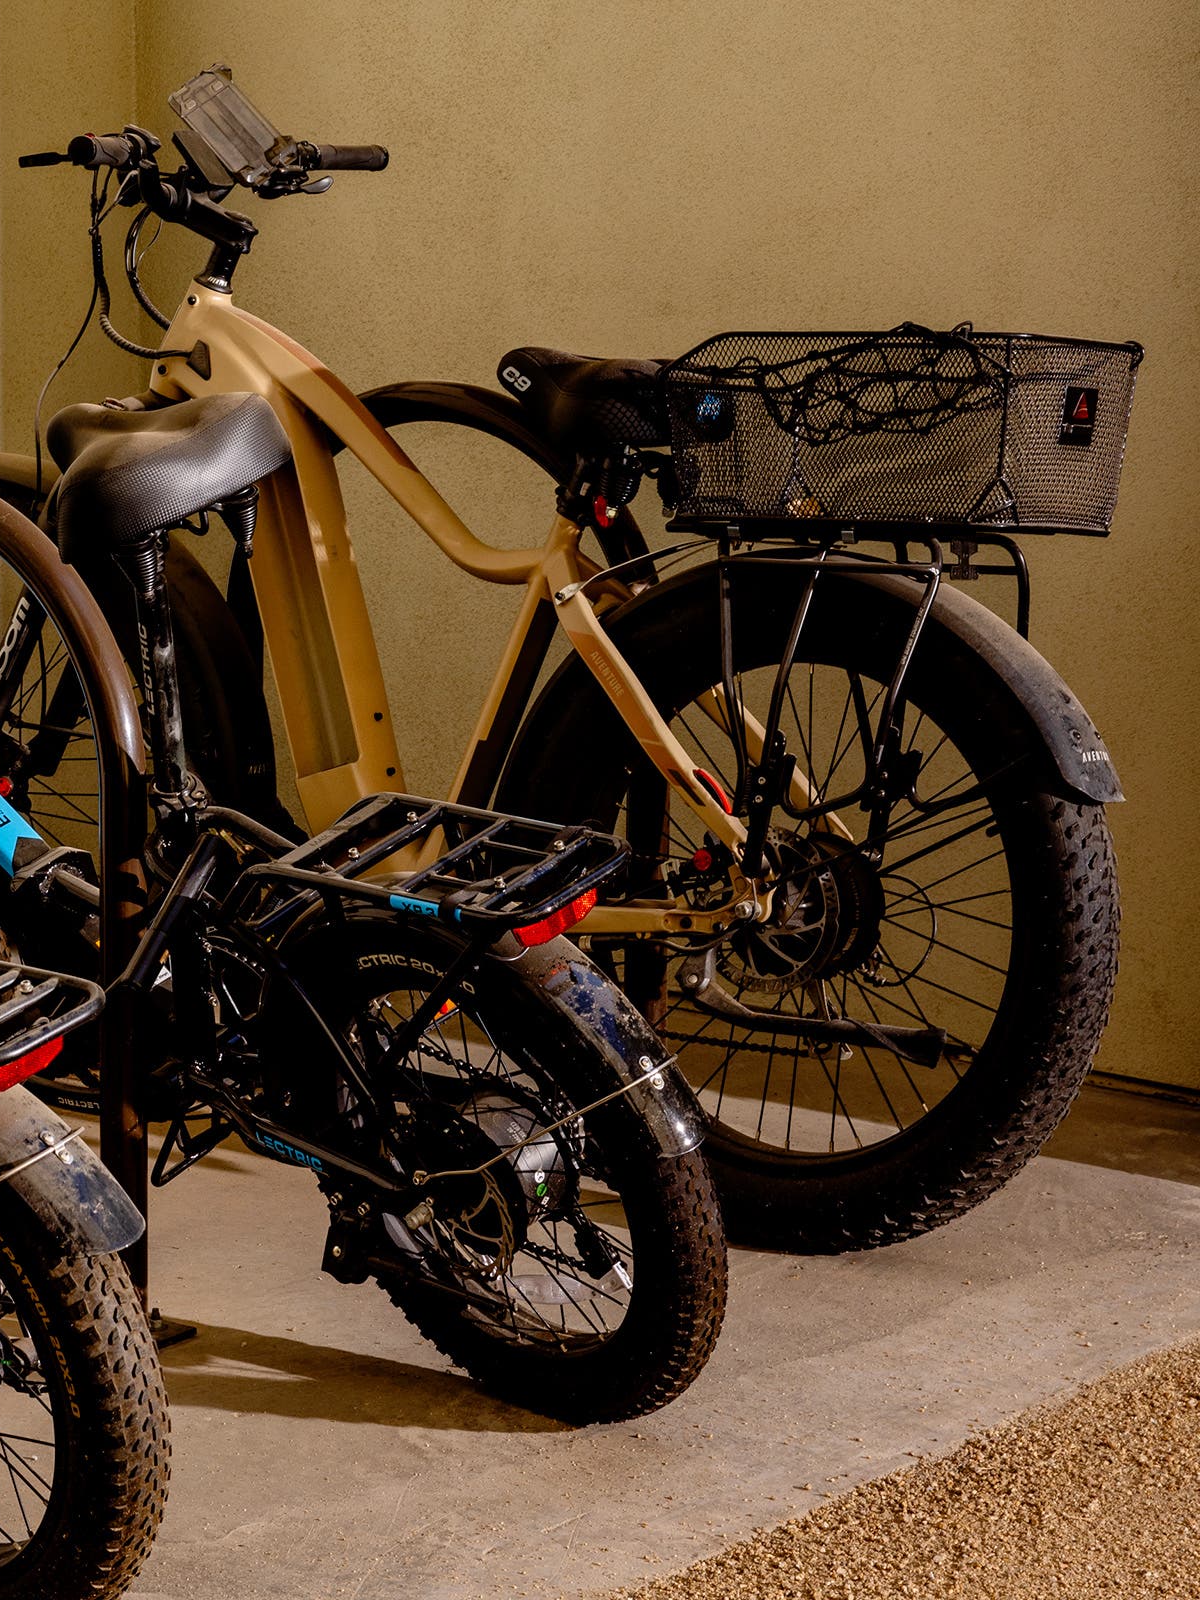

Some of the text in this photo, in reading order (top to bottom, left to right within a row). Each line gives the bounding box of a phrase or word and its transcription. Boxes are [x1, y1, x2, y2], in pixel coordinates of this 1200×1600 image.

[590, 651, 625, 697] AVENTURE
[255, 1131, 324, 1173] LECTRIC
[2, 1246, 50, 1331] PATROL
